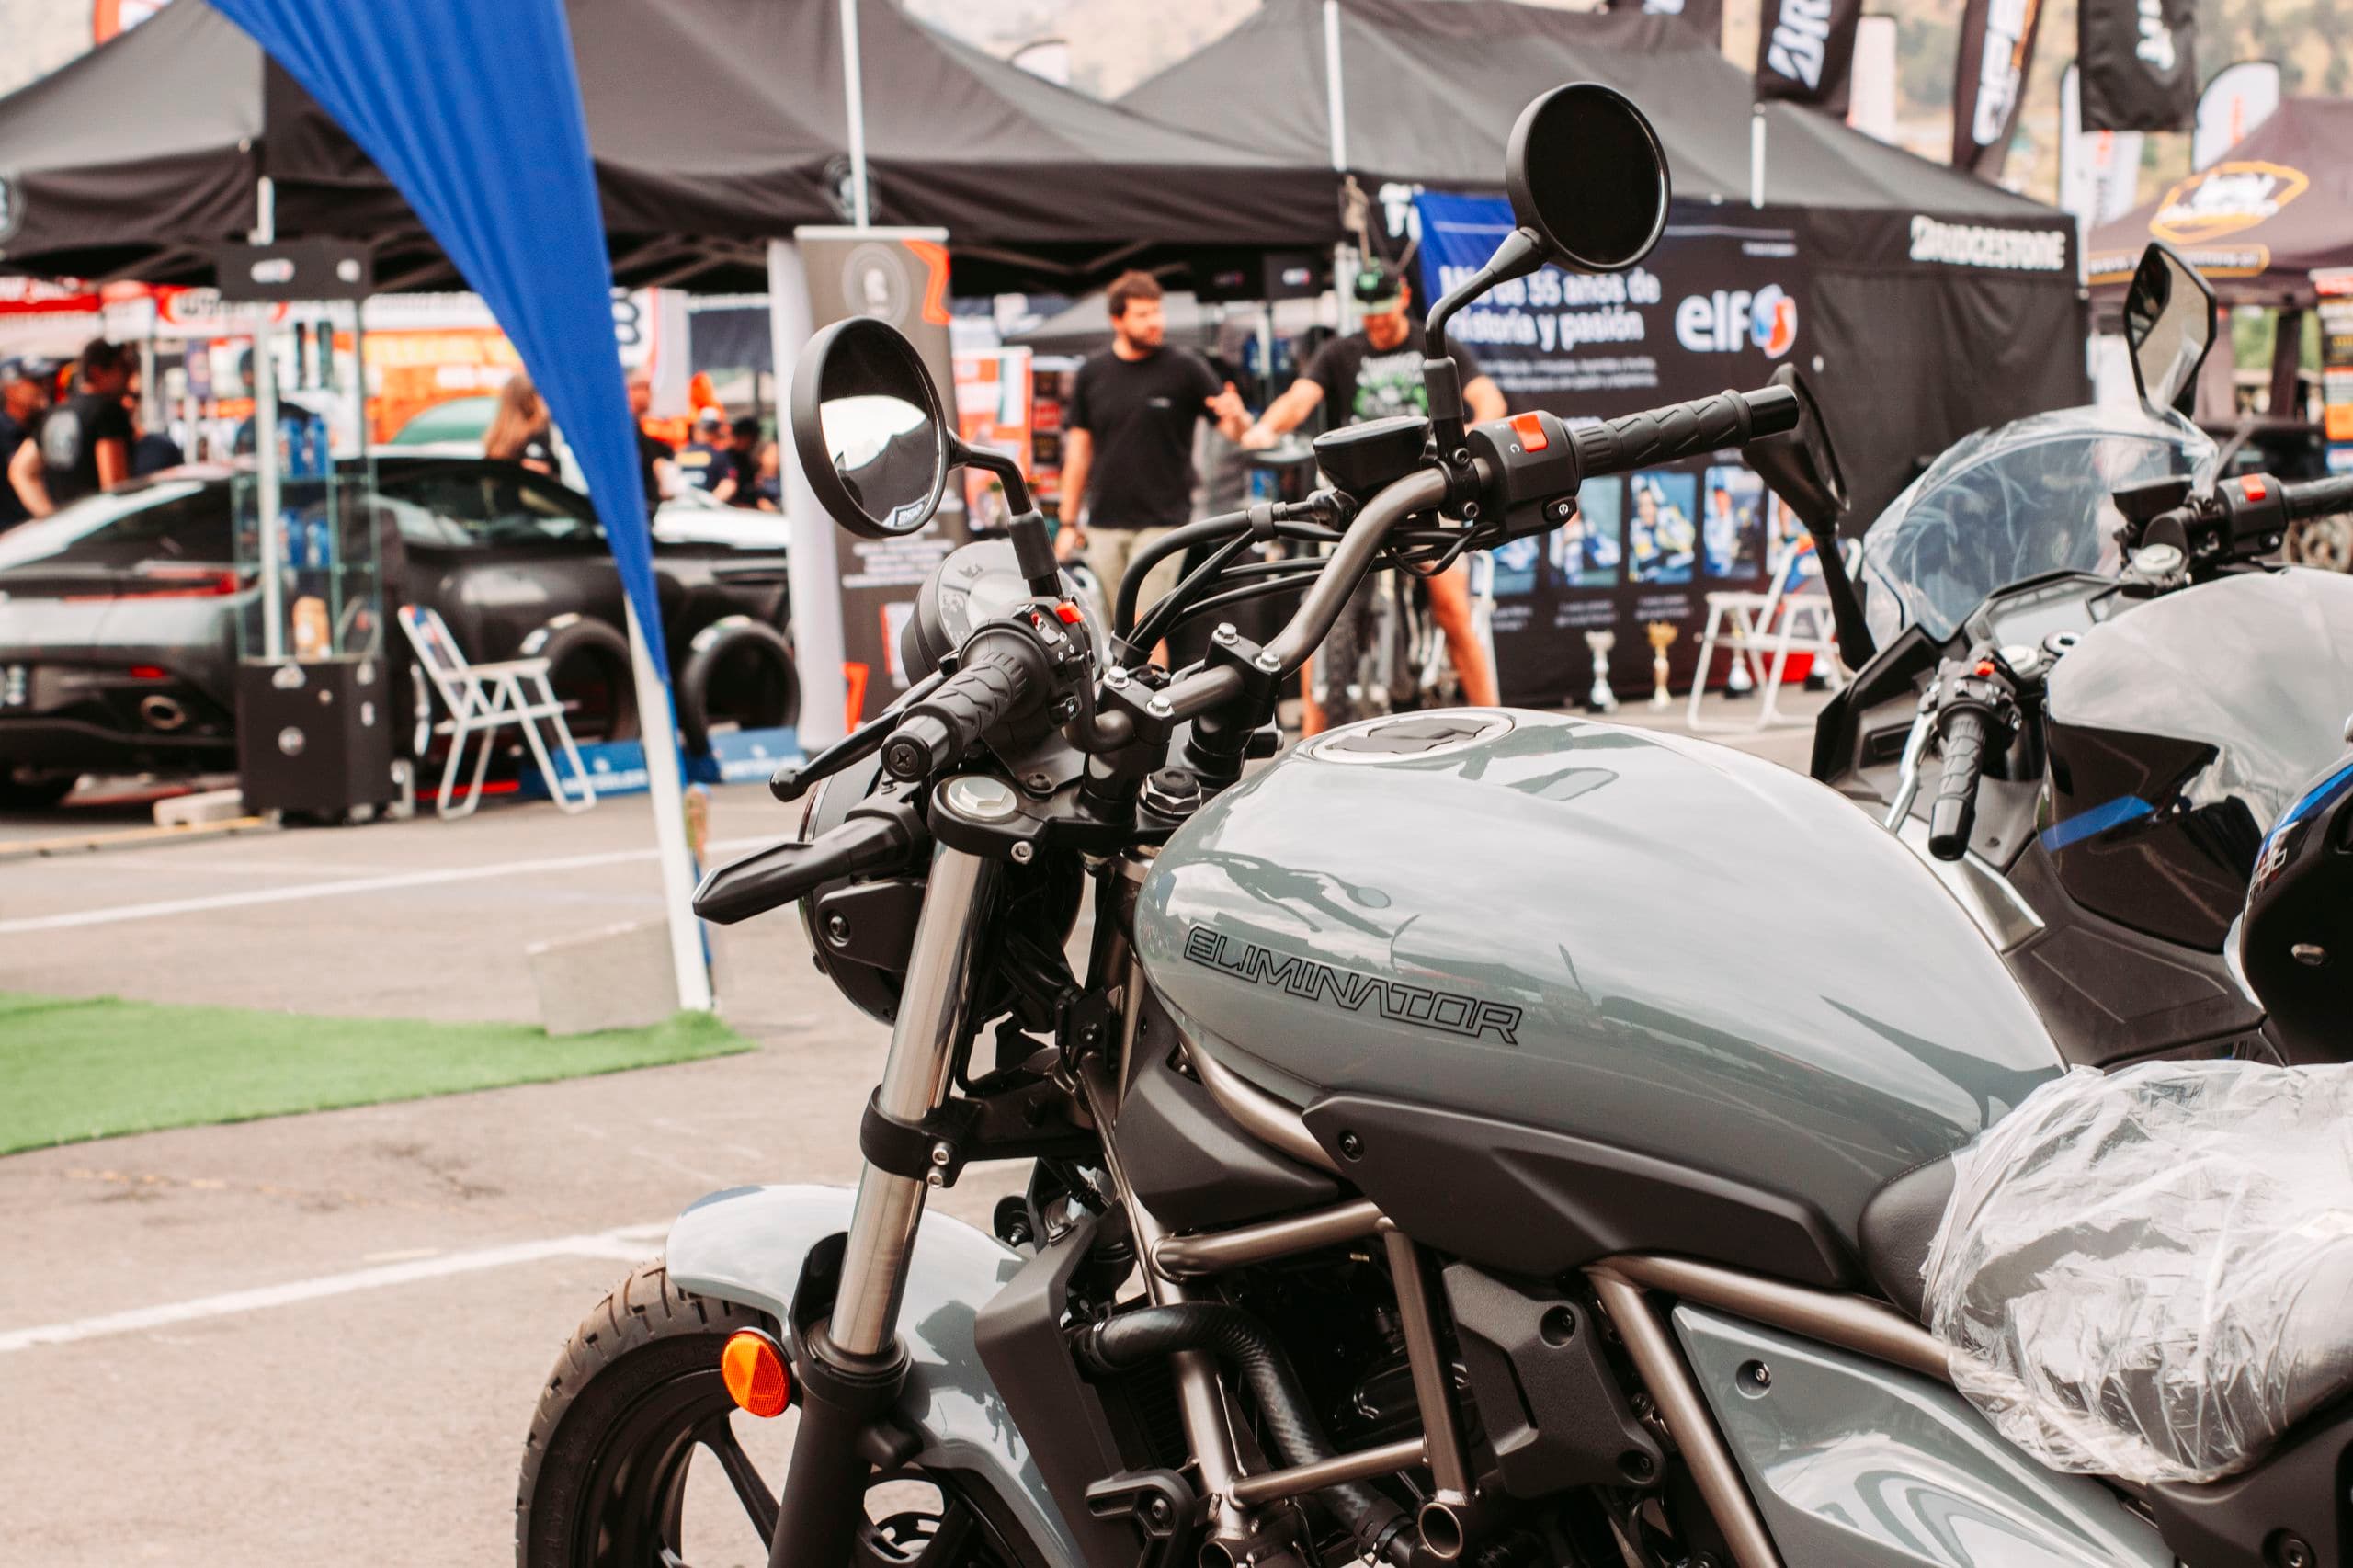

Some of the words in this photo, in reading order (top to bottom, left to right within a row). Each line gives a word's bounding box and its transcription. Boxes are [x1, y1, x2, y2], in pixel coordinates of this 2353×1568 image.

[1627, 266, 1661, 304] de
[1536, 313, 1556, 351] y
[1675, 290, 1752, 352] elf
[1184, 926, 1522, 1045] ELIMINATOR
